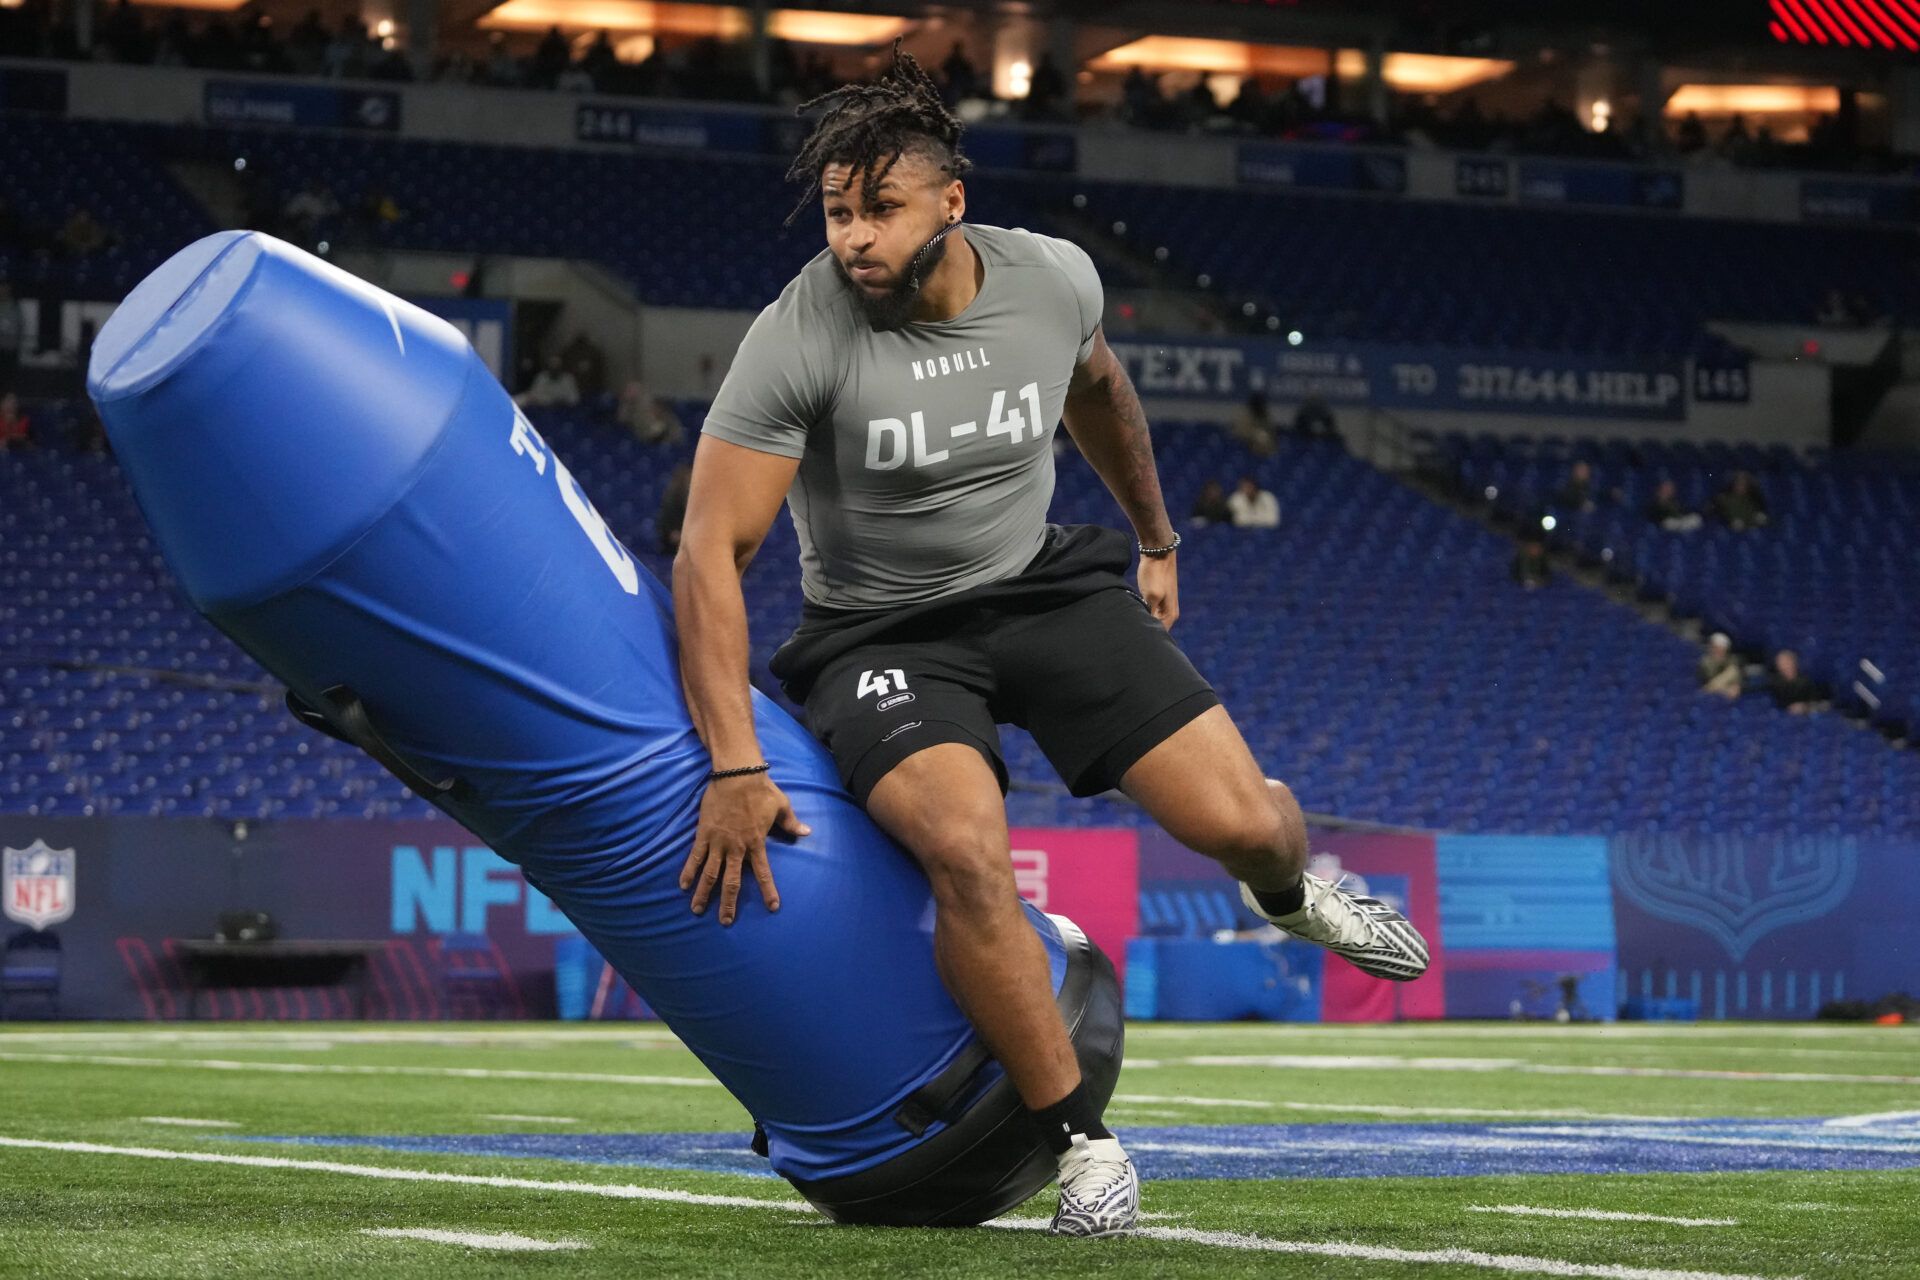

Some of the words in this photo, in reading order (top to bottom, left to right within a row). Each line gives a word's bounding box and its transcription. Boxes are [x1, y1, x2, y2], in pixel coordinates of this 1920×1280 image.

[912, 347, 991, 381] NOBULL
[1393, 363, 1438, 396] TO
[864, 381, 1044, 471] DL-41
[856, 668, 909, 700] 41
[15, 877, 65, 913] NFL
[390, 845, 581, 935] NFL
